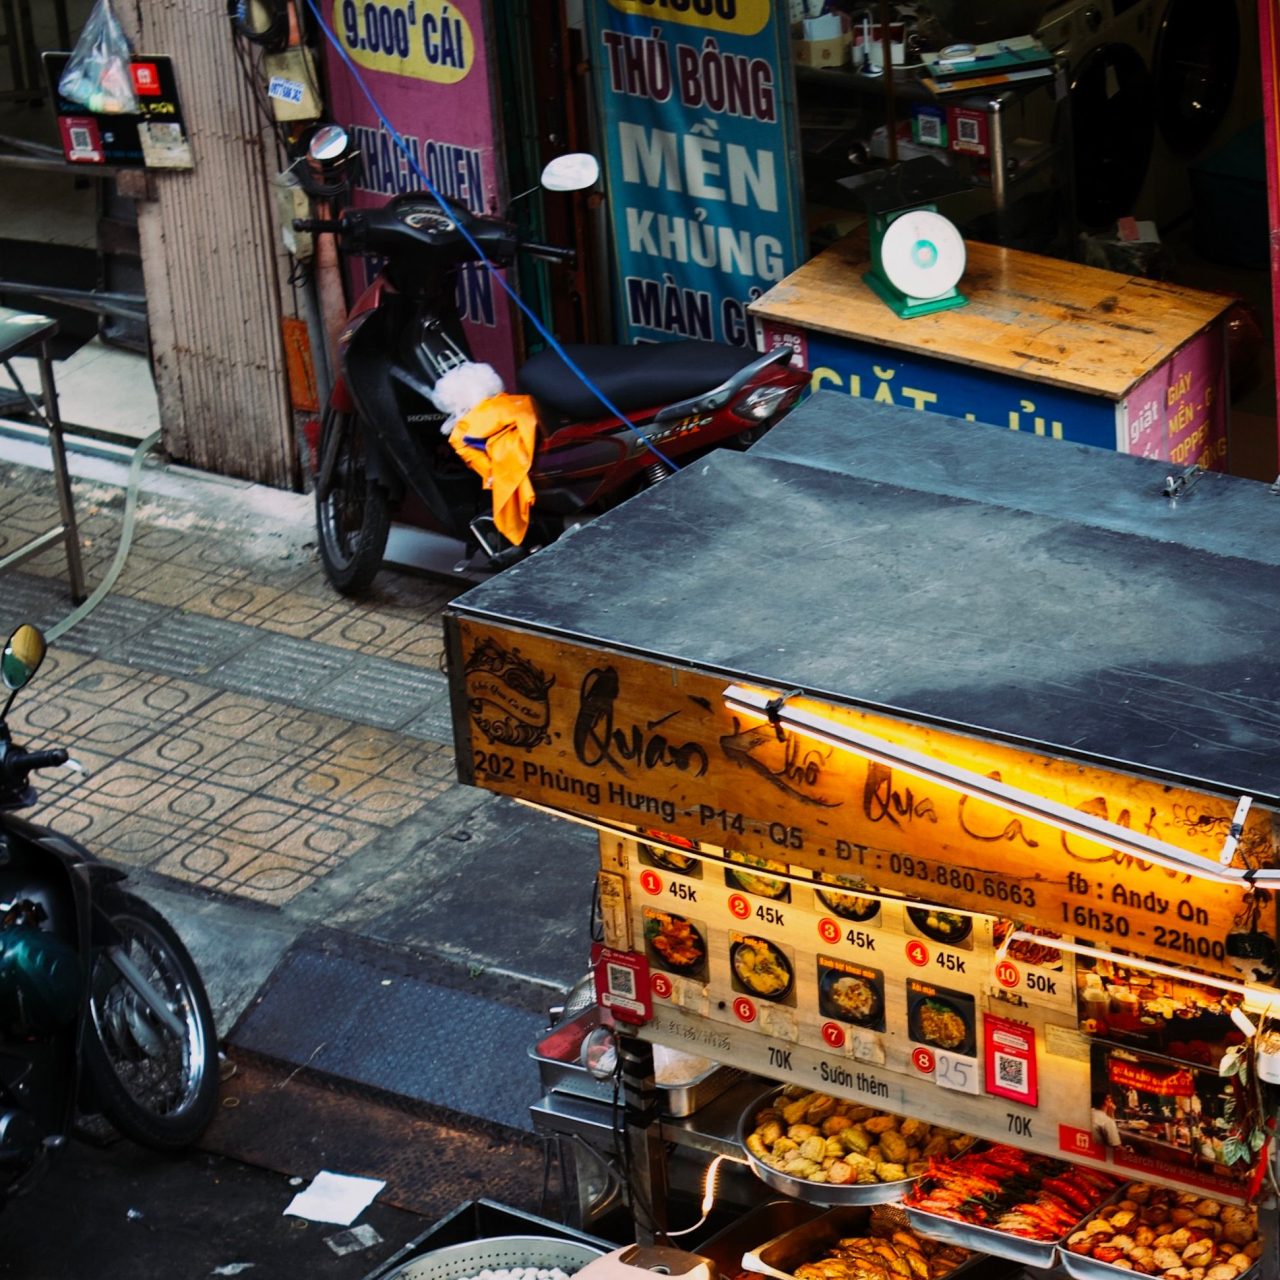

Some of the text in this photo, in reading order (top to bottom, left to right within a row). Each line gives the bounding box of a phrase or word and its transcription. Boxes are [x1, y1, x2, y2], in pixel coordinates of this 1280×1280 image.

[423, 6, 465, 69] CÁI
[603, 27, 777, 124] THÚ BÔNG
[618, 118, 779, 212] MỀN
[625, 207, 785, 281] KHỦNG
[625, 273, 713, 341] MÀN
[474, 750, 515, 779] 202
[523, 761, 600, 804] Phùng
[608, 782, 676, 823] Hưng
[700, 804, 745, 834] P14
[768, 822, 804, 848] Q5
[890, 854, 1036, 907] 093.880.6663
[669, 882, 697, 902] 45k
[756, 905, 784, 926] 45k
[1066, 872, 1088, 894] fb
[1112, 883, 1169, 914] Andy
[1177, 900, 1208, 926] On
[846, 930, 876, 951] 45k
[1061, 902, 1129, 937] 16h30
[1154, 926, 1225, 961] 22h00
[936, 952, 966, 973] 45k
[999, 967, 1057, 995] 10 50k
[768, 1047, 792, 1072] 70K
[857, 1072, 889, 1099] thêm
[1006, 1113, 1032, 1138] 70K
